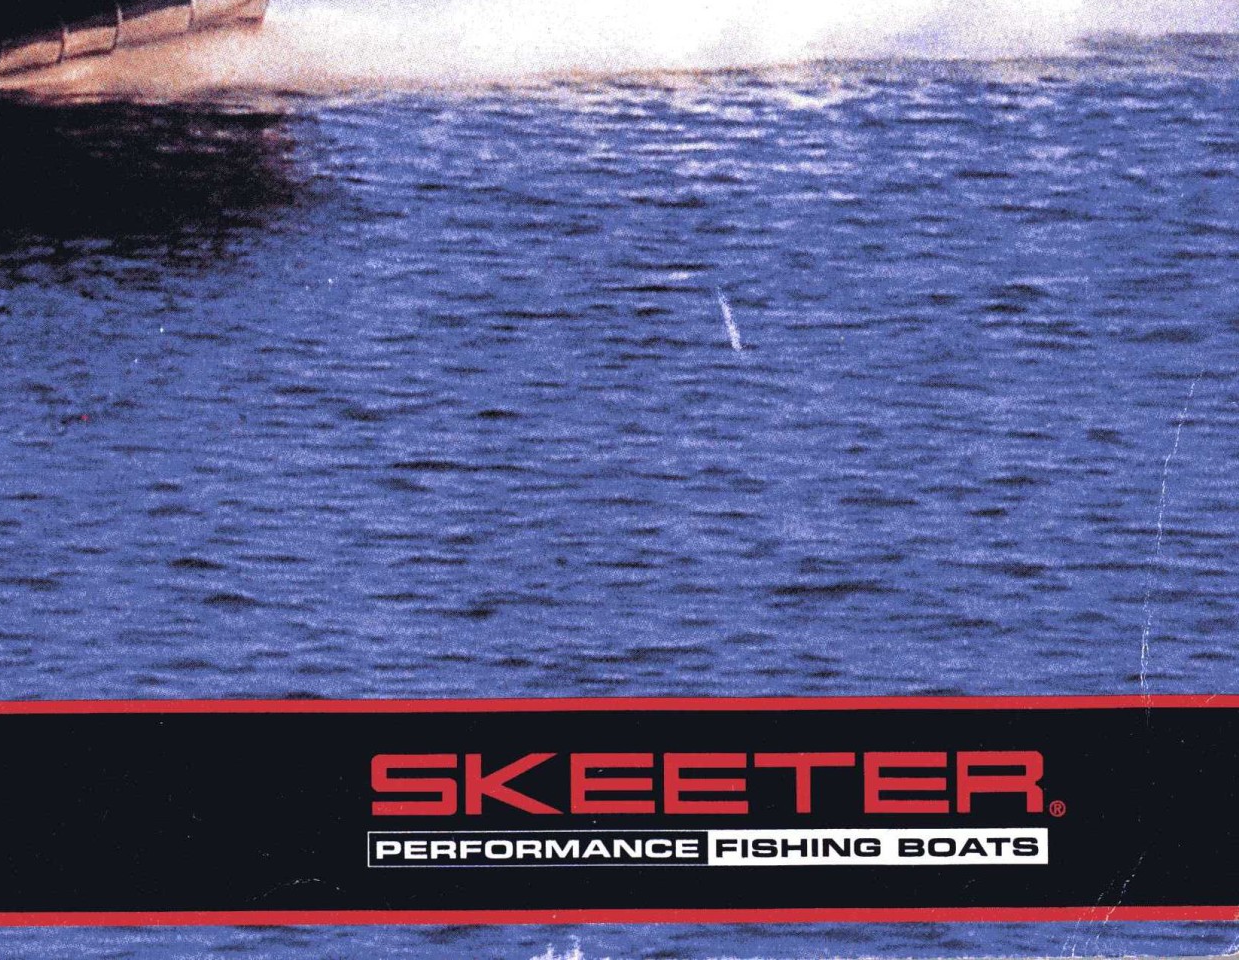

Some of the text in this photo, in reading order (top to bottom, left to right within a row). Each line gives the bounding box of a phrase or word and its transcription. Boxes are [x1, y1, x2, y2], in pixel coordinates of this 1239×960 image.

[371, 751, 1044, 815] SKEETER
[376, 837, 1039, 859] PERFORMANCE FISHING BOATS
